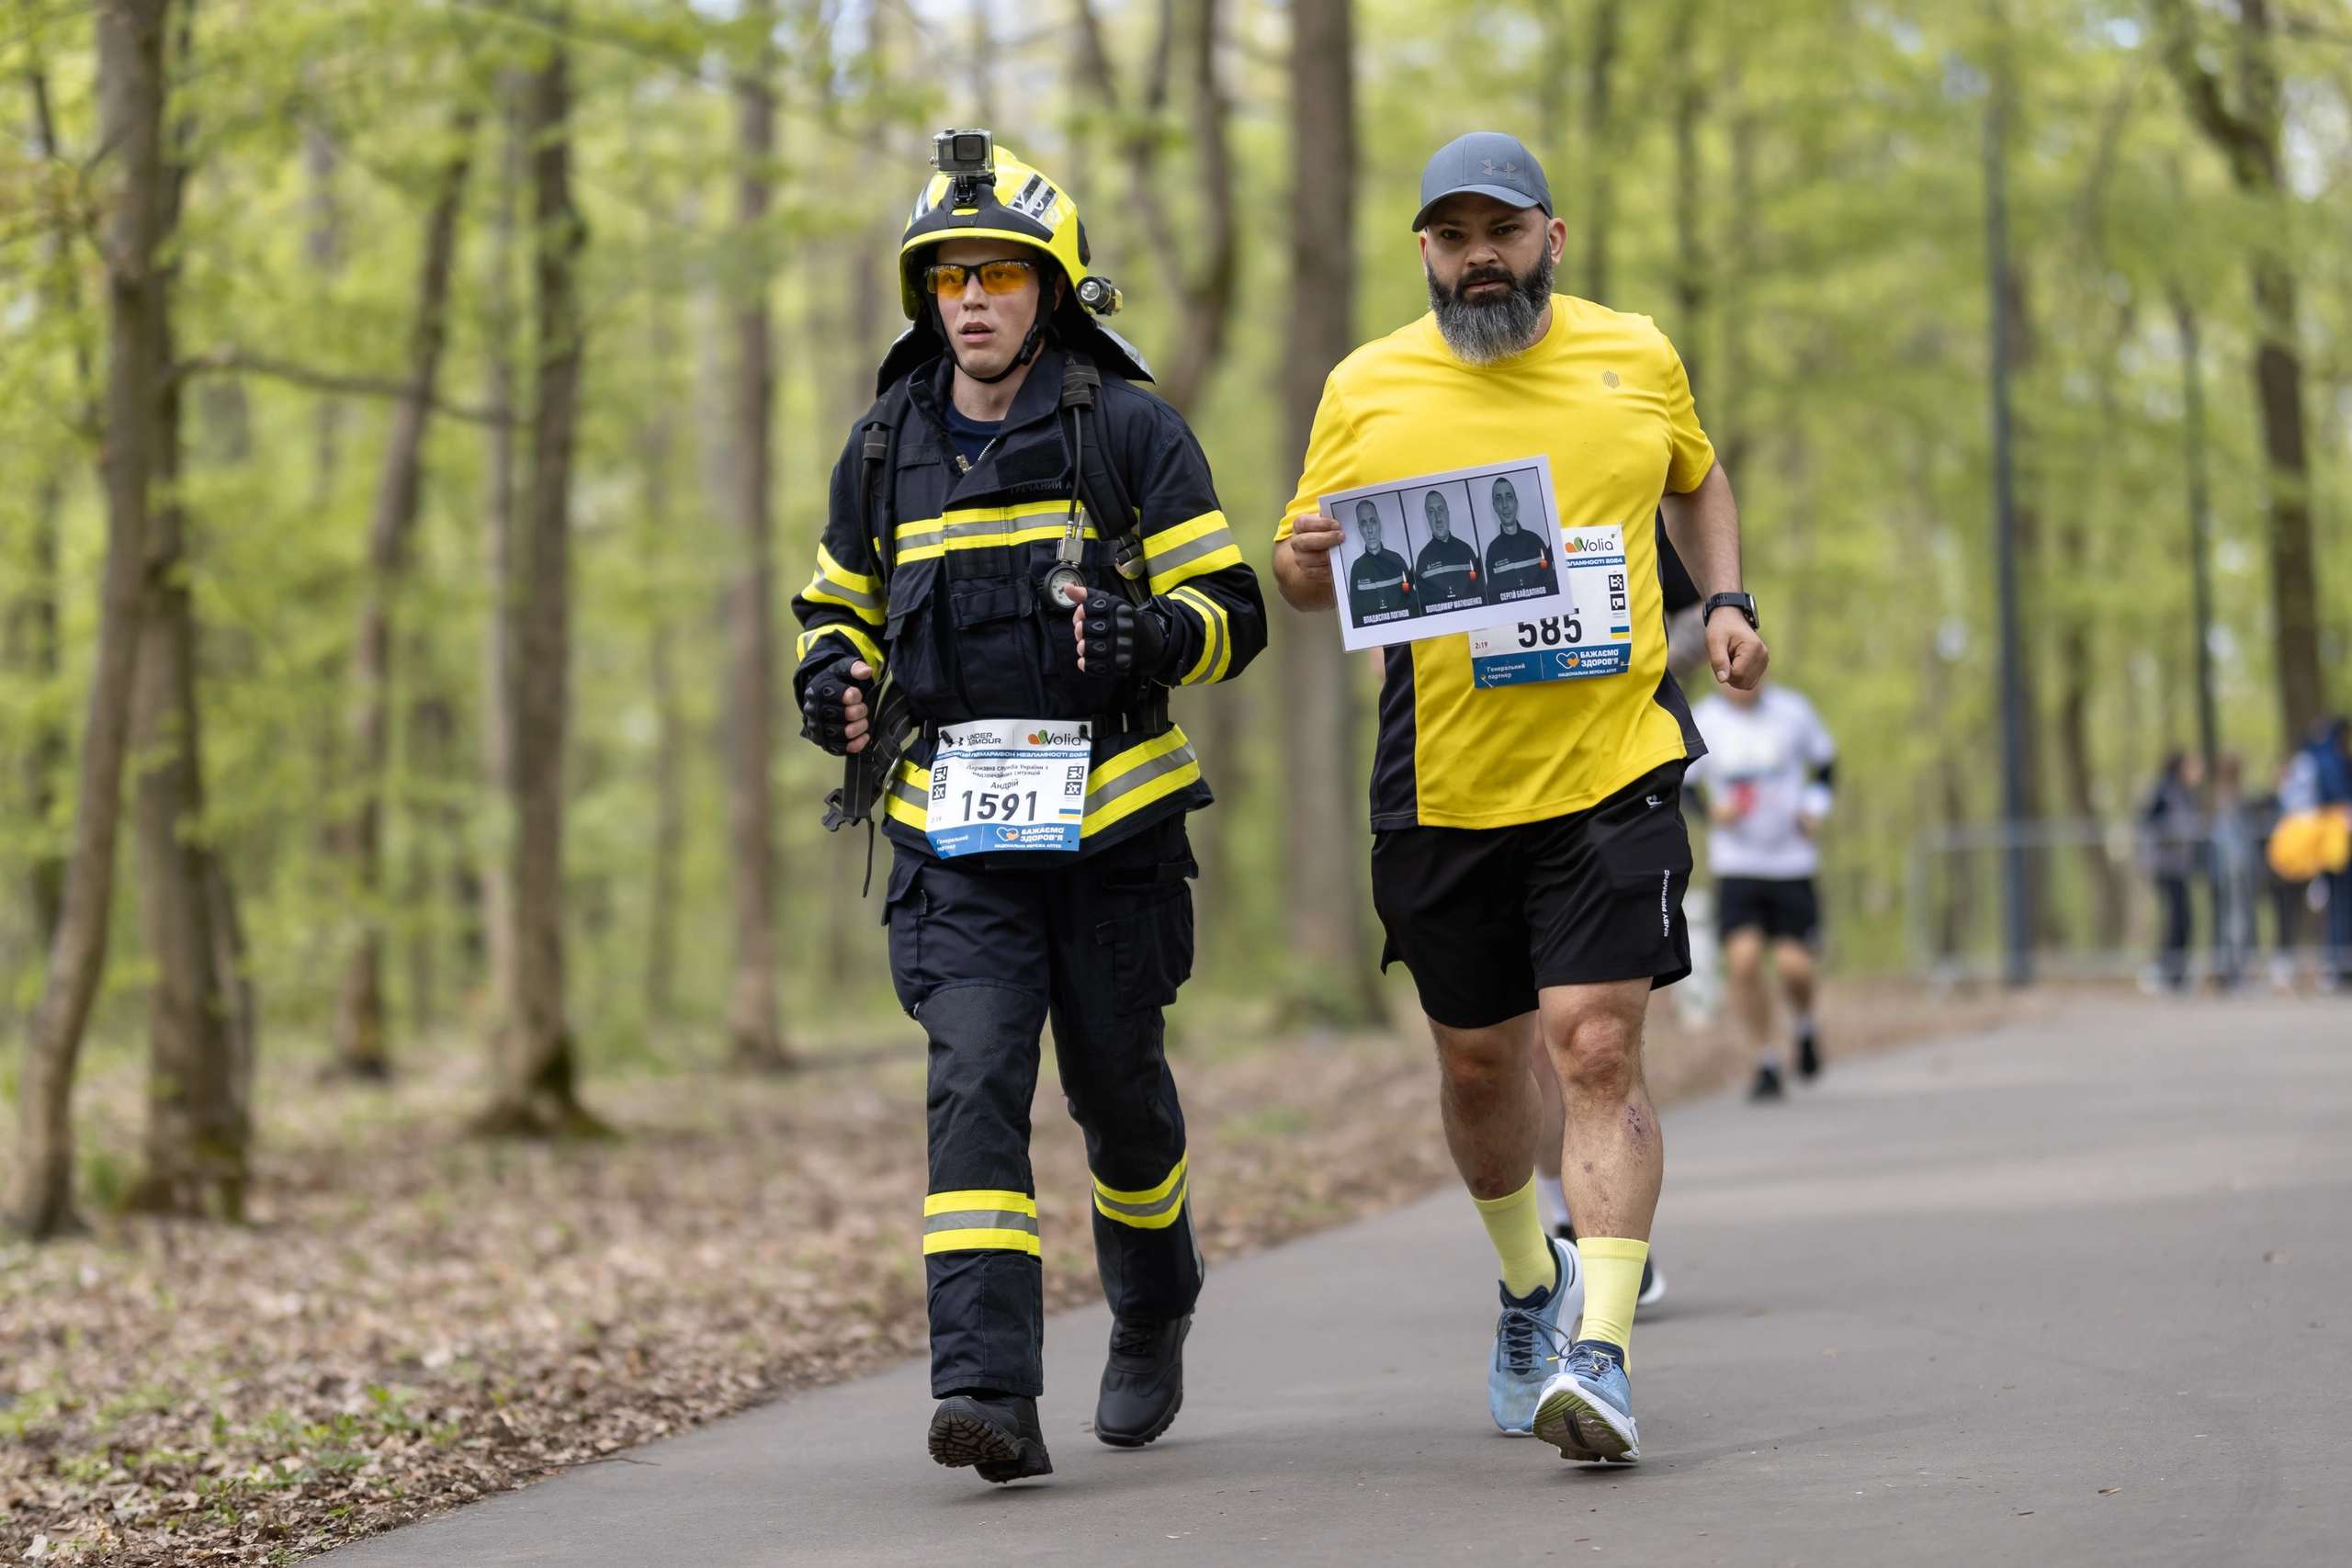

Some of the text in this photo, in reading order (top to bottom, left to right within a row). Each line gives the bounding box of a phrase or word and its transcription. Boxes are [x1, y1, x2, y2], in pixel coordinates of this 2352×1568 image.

[1579, 537, 1614, 552] Volia
[1566, 558, 1605, 567] ЗЛАМНОСТІ
[1499, 589, 1517, 602] СЕРГІЙ
[1425, 601, 1453, 614] ВОЛОДИМИР
[1518, 608, 1582, 648] 585
[1475, 641, 1488, 649] 2:19
[1580, 649, 1620, 659] БАЖАЄМО
[1487, 663, 1526, 673] Генеральний
[1580, 658, 1619, 668] ЗДОРОВ'Я
[1487, 672, 1512, 681] партнер
[967, 732, 993, 741] UNDER
[1045, 732, 1082, 746] Volia
[967, 738, 1001, 747] ARMOUR
[990, 779, 1019, 790] Андрій
[962, 790, 1037, 822] 1591
[1021, 827, 1064, 835] БАЖАЄМО
[936, 834, 968, 845] Генеральний
[1020, 834, 1063, 843] ЗДОРОВ'Я
